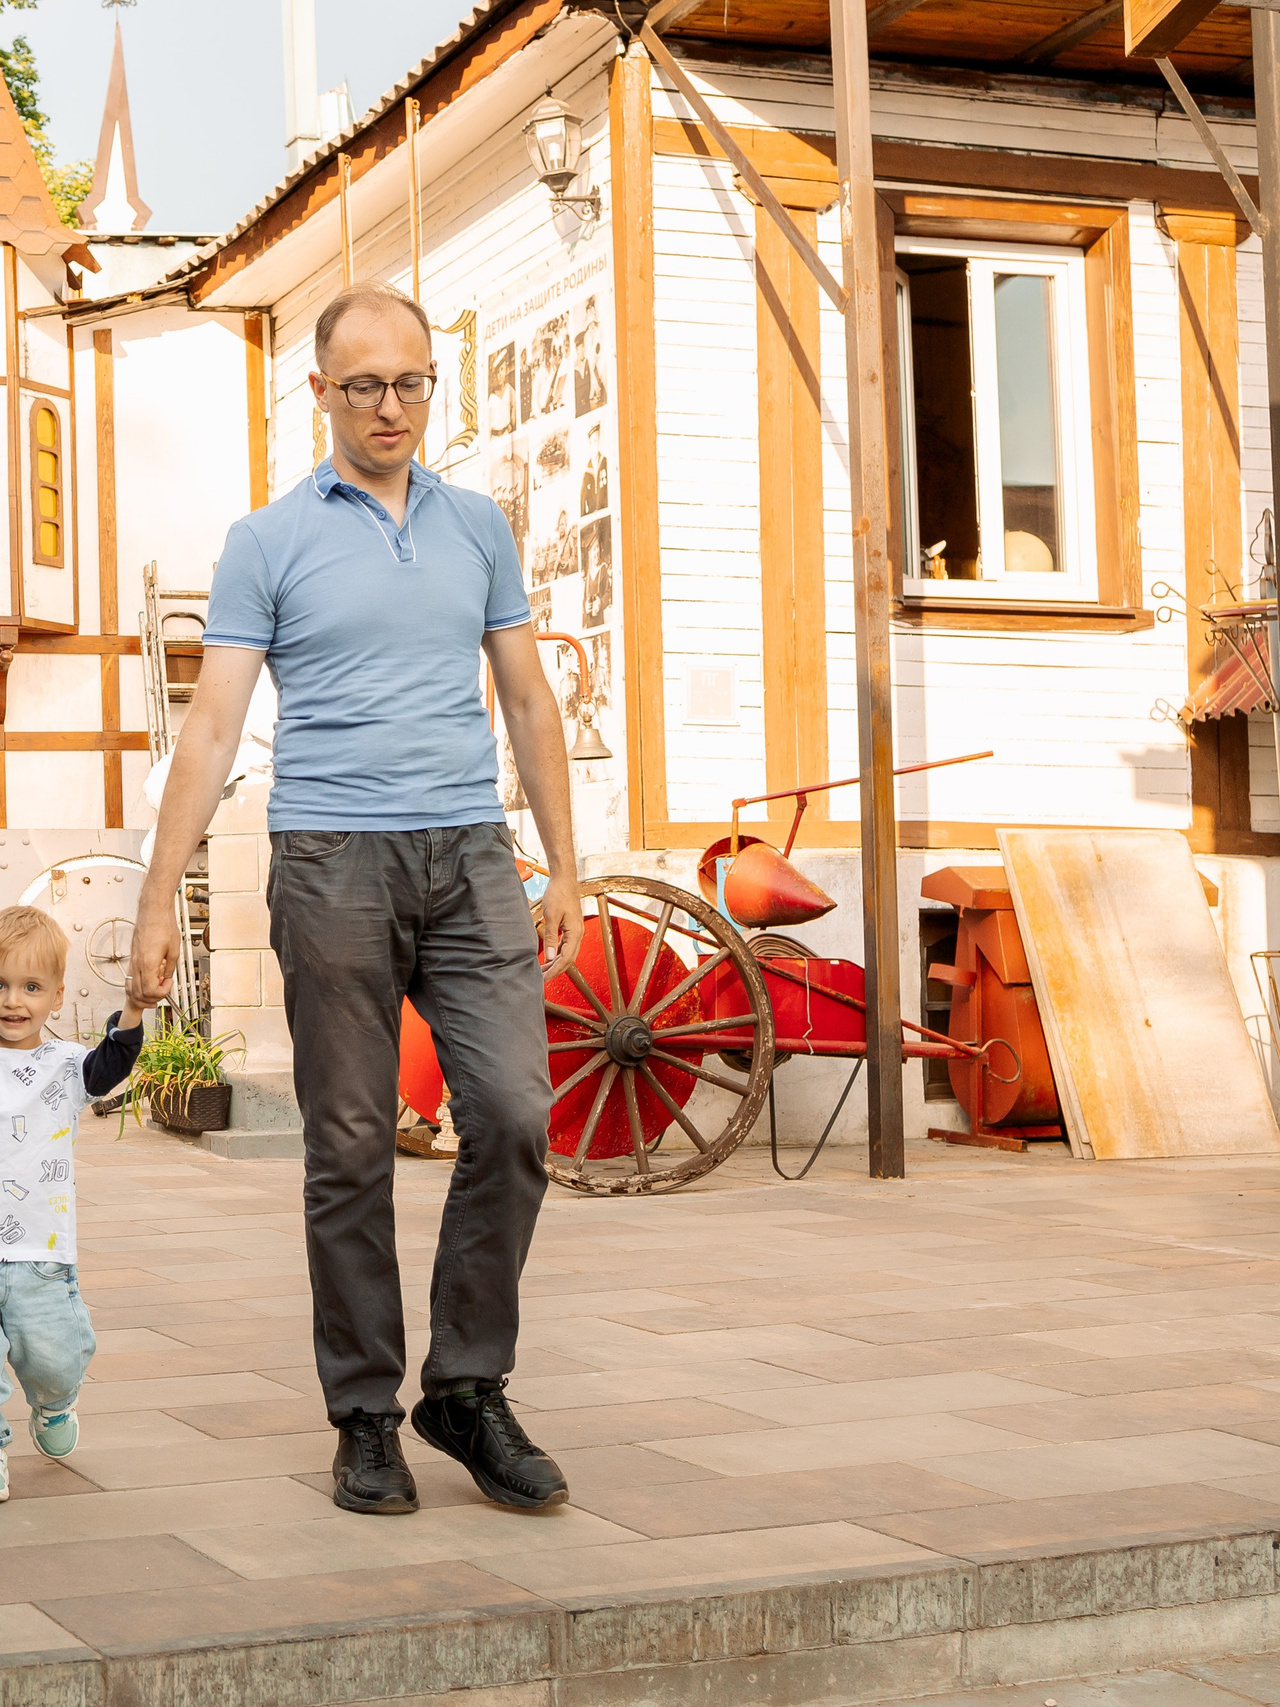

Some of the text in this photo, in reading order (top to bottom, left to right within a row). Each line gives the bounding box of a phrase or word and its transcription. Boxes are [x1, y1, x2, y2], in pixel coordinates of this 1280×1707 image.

[484, 253, 607, 342] ДЕТИ НА ЗАЩИТЕ РОДИНЫ
[11, 1067, 33, 1087] RULES
[23, 1065, 37, 1077] NO
[39, 1080, 69, 1111] OK
[39, 1159, 70, 1183] OK
[54, 1205, 67, 1214] NO
